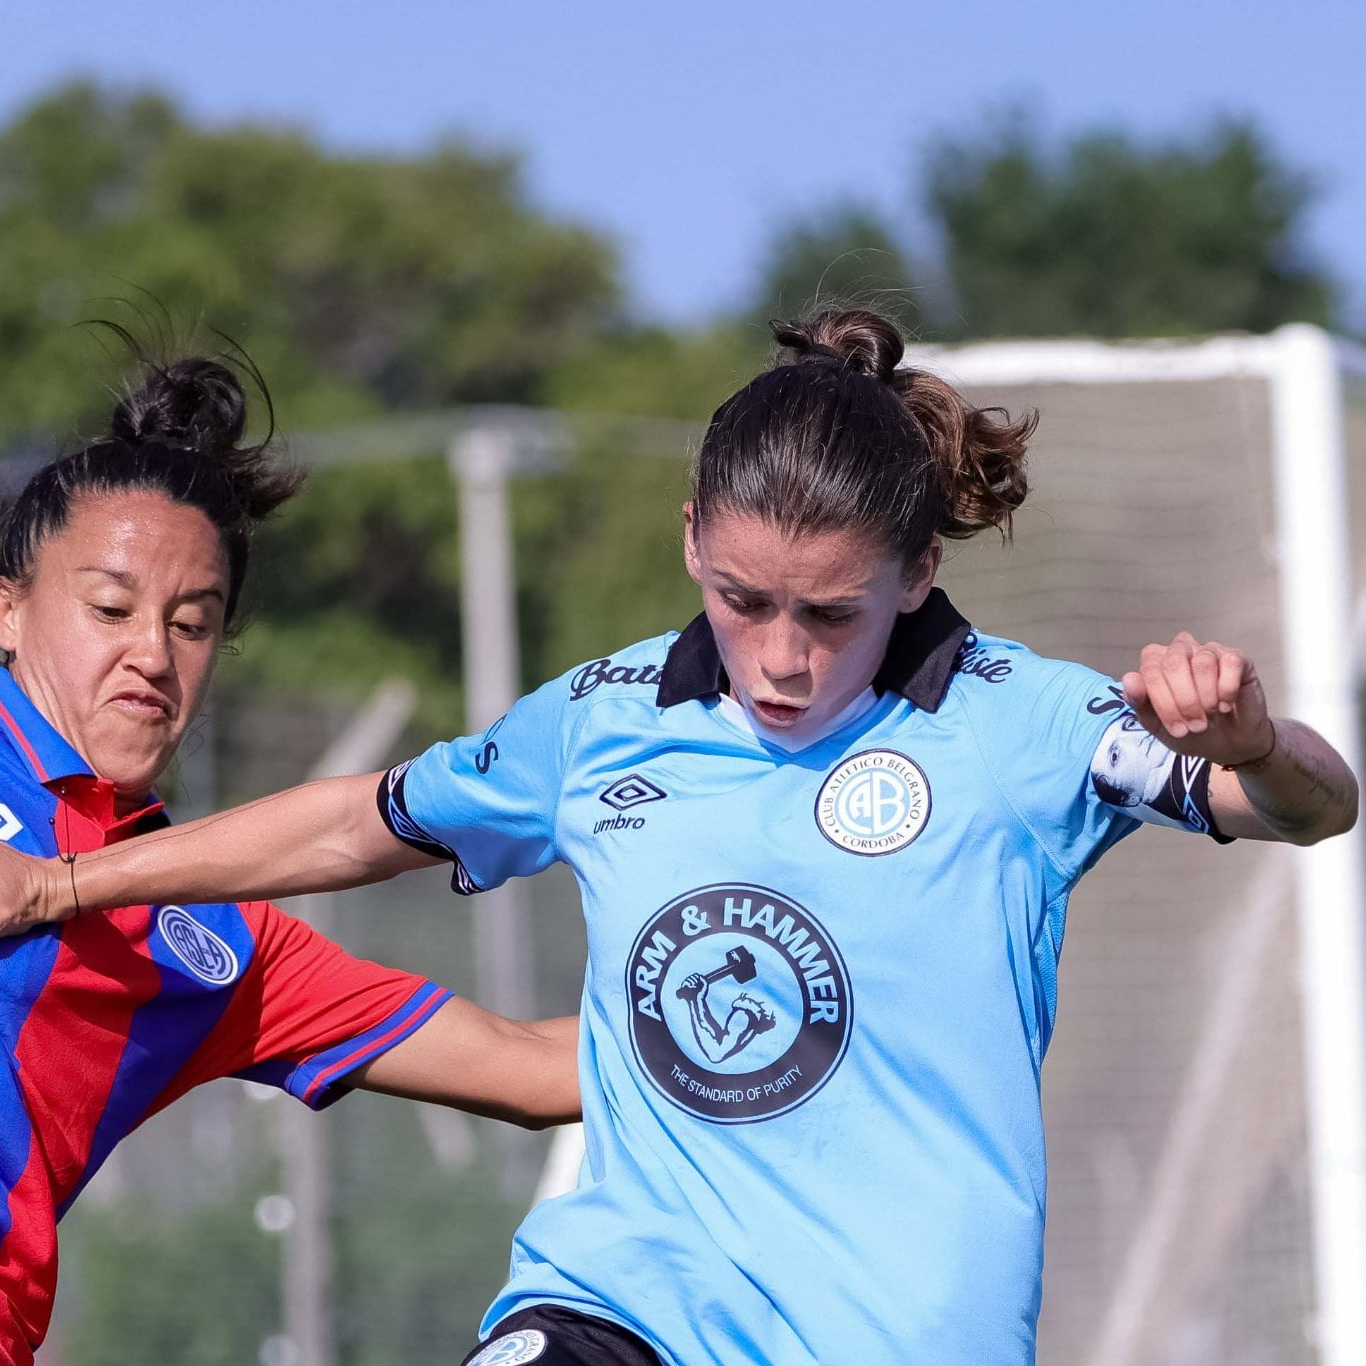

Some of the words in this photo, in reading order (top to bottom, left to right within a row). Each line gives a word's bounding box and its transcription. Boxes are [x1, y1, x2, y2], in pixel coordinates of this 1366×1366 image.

[823, 797, 835, 827] CLUB
[830, 757, 883, 792] ATLETICO
[887, 758, 922, 820] BELGRANO
[593, 813, 645, 834] umbro
[842, 831, 905, 849] CORDOBA
[635, 930, 677, 1022] ARM
[680, 904, 712, 936] &
[723, 897, 839, 1025] HAMMER
[670, 1064, 689, 1087] THE
[687, 1080, 744, 1103] STANDARD
[746, 1087, 763, 1101] OF
[763, 1064, 803, 1097] PURITY
